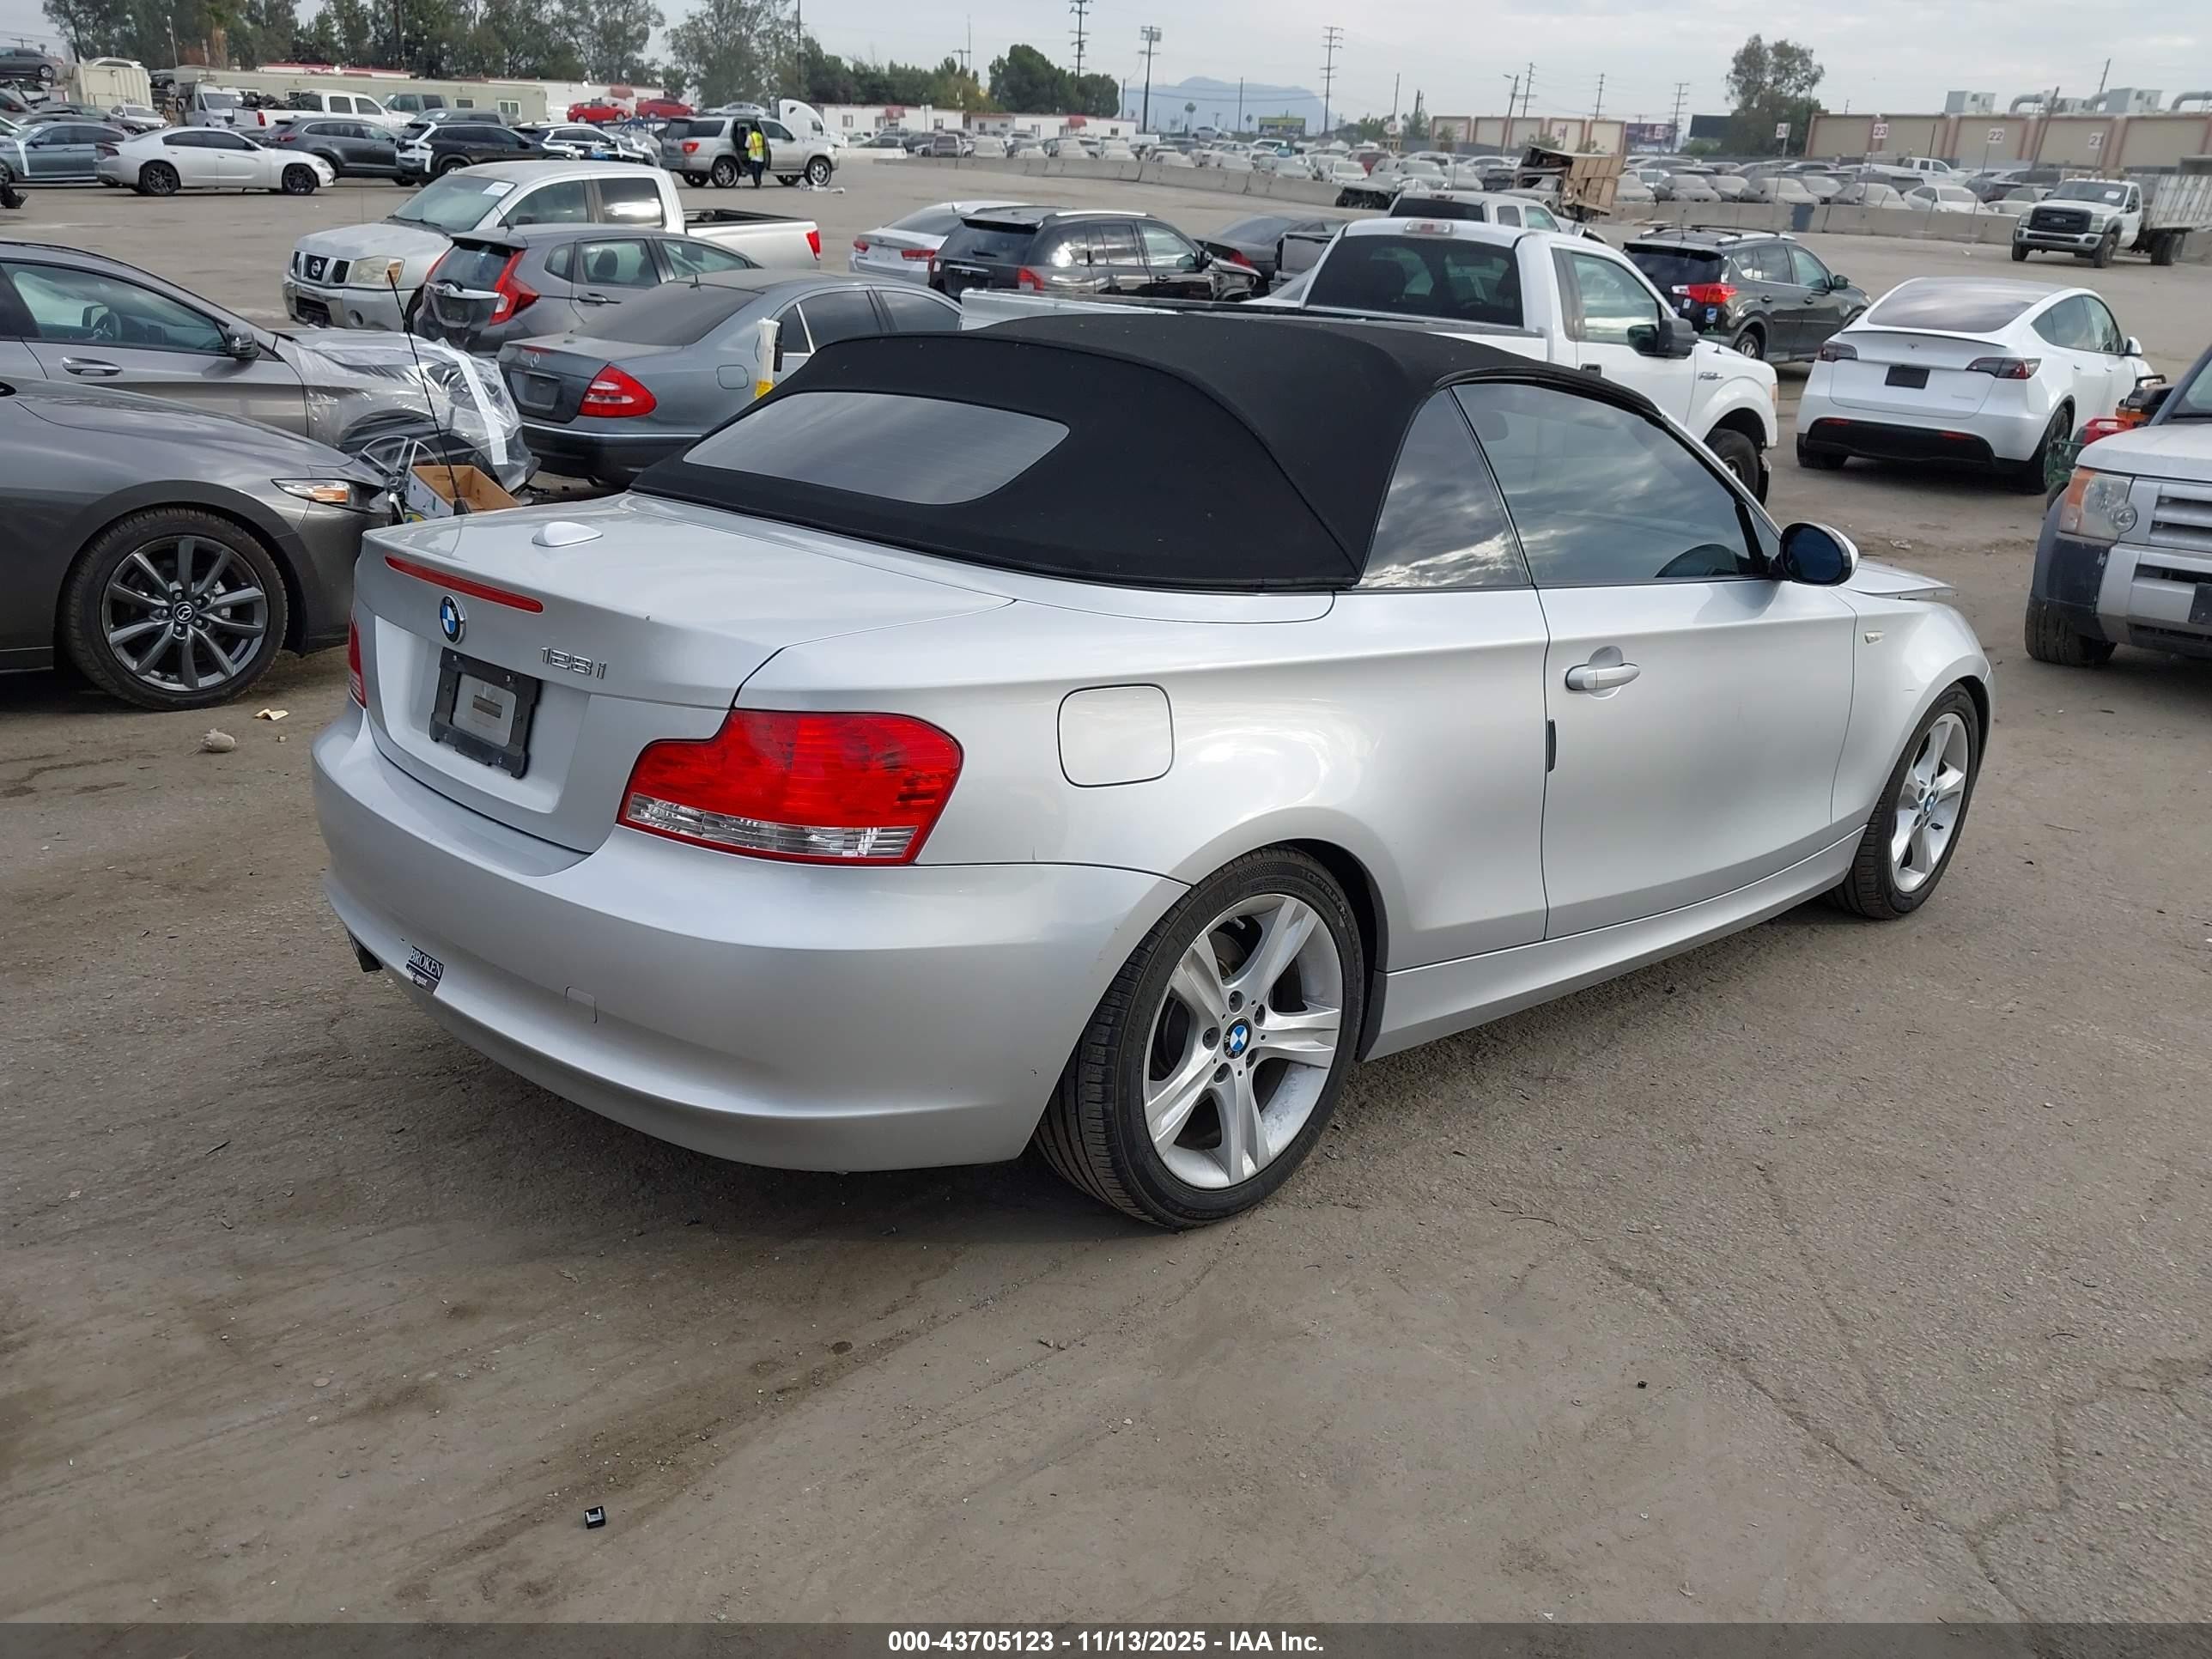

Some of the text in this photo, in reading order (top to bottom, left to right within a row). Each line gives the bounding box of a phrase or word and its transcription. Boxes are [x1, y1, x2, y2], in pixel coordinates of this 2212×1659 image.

[1875, 126, 1887, 136] 23
[1989, 131, 2003, 141] 22
[540, 647, 606, 680] 128i
[410, 946, 443, 978] BROKEN
